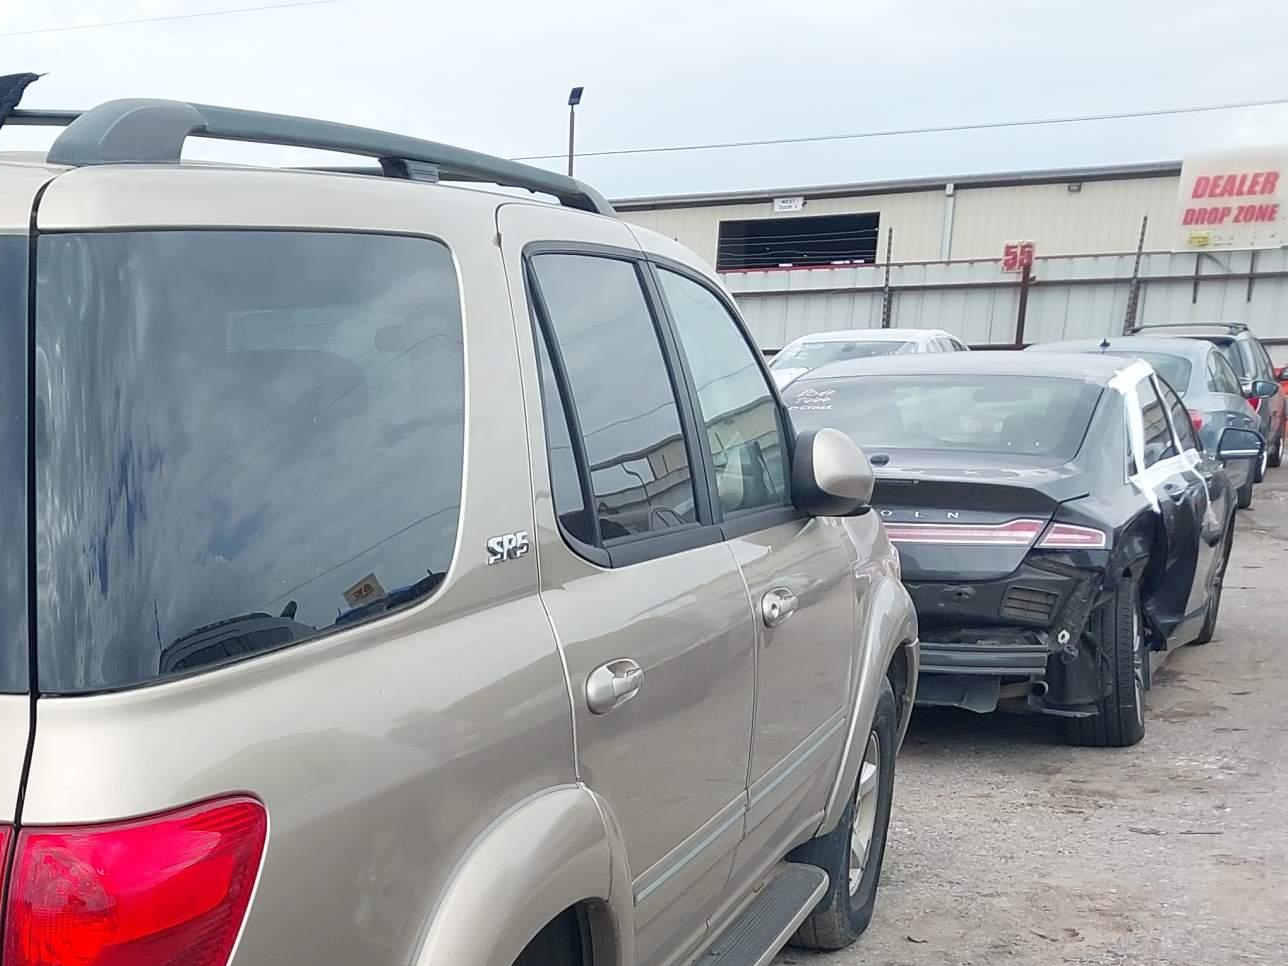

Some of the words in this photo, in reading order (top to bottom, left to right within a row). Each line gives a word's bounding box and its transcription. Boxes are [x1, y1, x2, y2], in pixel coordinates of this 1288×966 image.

[1192, 171, 1280, 199] DEALER
[1182, 207, 1232, 226] DROP
[1232, 204, 1280, 223] ZONE
[487, 531, 529, 566] SR5
